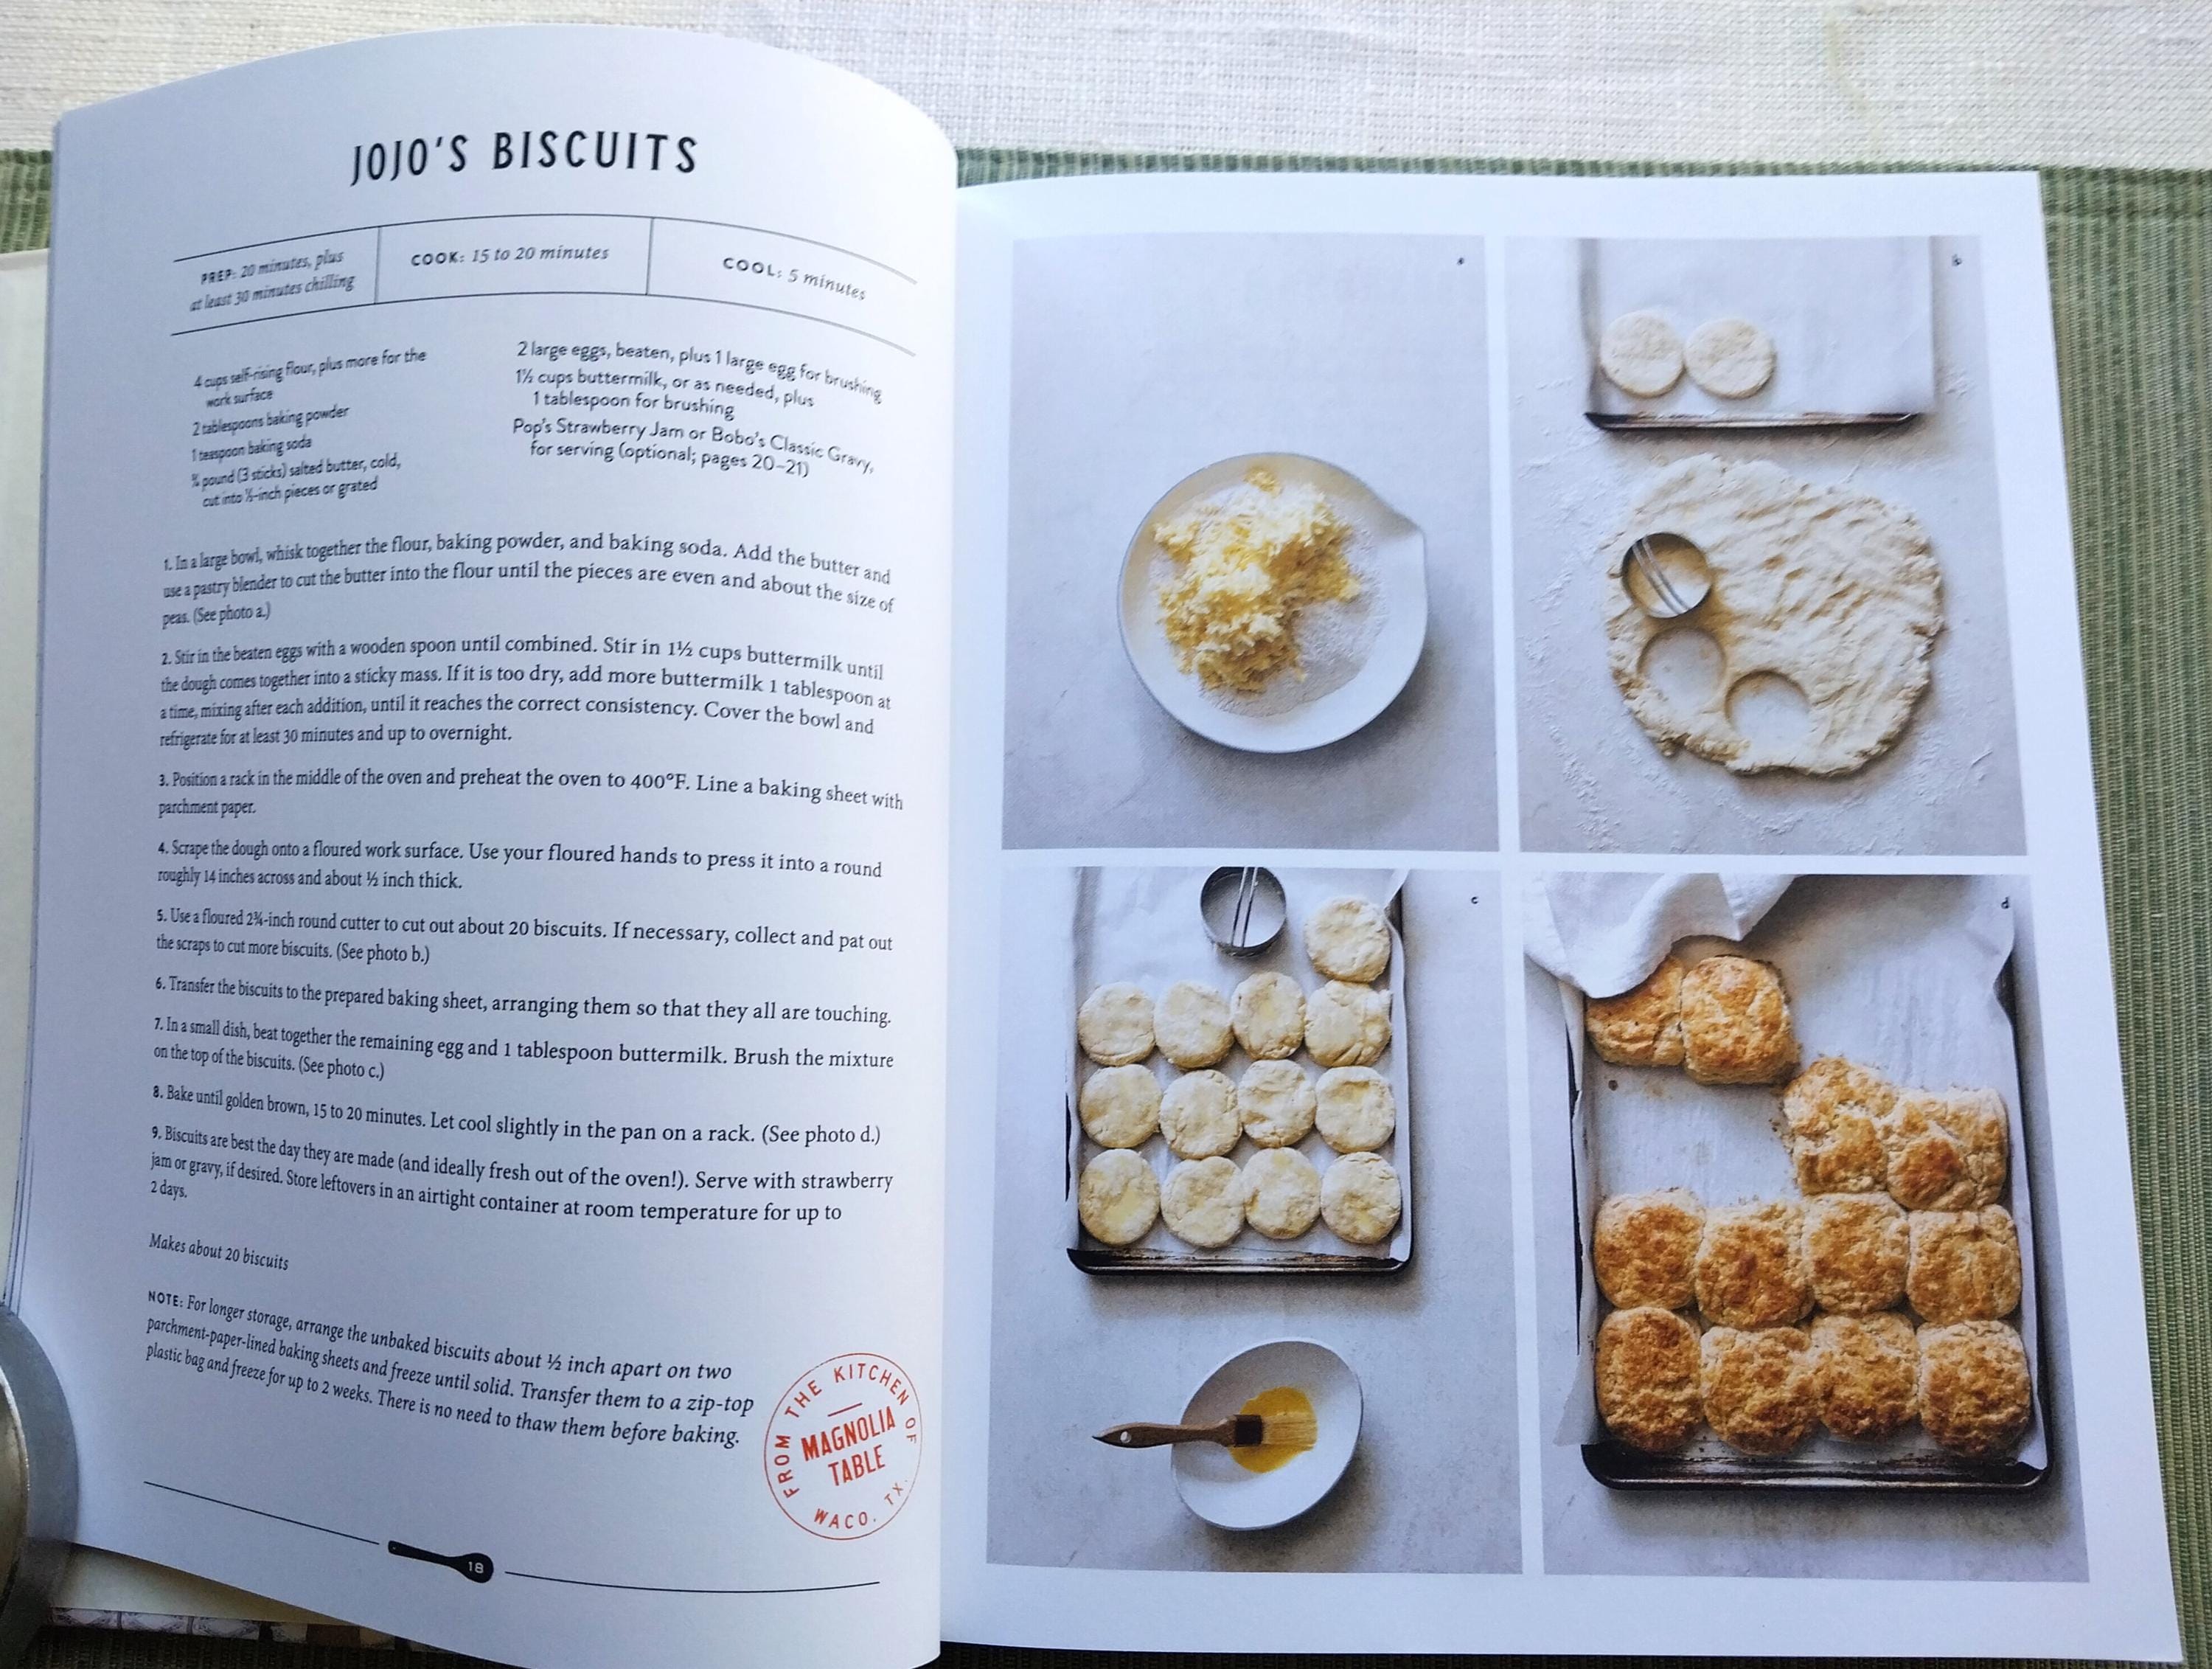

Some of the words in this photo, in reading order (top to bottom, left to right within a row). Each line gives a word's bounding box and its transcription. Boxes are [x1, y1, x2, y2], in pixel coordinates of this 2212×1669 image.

[349, 134, 469, 187] JOJO'S
[492, 130, 698, 174] BISCUITS
[201, 268, 237, 285] PREP:
[240, 264, 256, 278] 20
[257, 258, 313, 275] minutes,
[314, 249, 344, 271] plus
[411, 251, 465, 267] COOK:
[472, 249, 490, 264] 15
[494, 249, 510, 261] to
[514, 246, 536, 260] 20
[539, 245, 610, 260] minutes
[189, 299, 203, 312] at
[204, 294, 232, 309] least
[234, 289, 250, 306] 30
[252, 283, 303, 301] minutes
[304, 274, 356, 293] chilling
[723, 257, 782, 278] COOL:
[787, 268, 799, 283] 5
[803, 274, 865, 301] minutes
[193, 375, 203, 387] 4
[204, 375, 229, 390] cups
[230, 364, 284, 384] self-rising
[285, 361, 316, 375] flour,
[319, 356, 343, 377] plus
[346, 355, 379, 369] more
[381, 349, 402, 364] for
[404, 347, 427, 363] the
[517, 341, 528, 357] 2
[531, 341, 568, 362] large
[571, 345, 611, 362] eggs,
[616, 341, 675, 363] beaten,
[679, 347, 711, 367] plus
[716, 350, 721, 364] 1
[726, 350, 764, 375] large
[768, 362, 796, 382] egg
[800, 363, 821, 381] for
[825, 369, 882, 405] brushing
[538, 373, 573, 389] cups
[577, 368, 667, 390] buttermilk,
[672, 378, 690, 389] or
[694, 380, 711, 391] as
[715, 382, 779, 403] needed,
[783, 389, 814, 408] plus
[192, 421, 200, 437] 2
[201, 417, 264, 436] tablespoons
[266, 411, 304, 428] baking
[305, 404, 350, 427] powder
[534, 391, 539, 406] 1
[543, 390, 630, 412] tablespoon
[635, 392, 660, 409] for
[664, 394, 734, 422] brushing
[512, 417, 552, 439] Pop's
[556, 417, 647, 442] Strawberry
[649, 421, 684, 438] Jam
[689, 429, 706, 440] or
[712, 426, 765, 448] Bobo's
[770, 434, 824, 459] Classic
[827, 445, 874, 475] Gravy,
[161, 652, 172, 666] 2.
[175, 649, 195, 665] Stir
[197, 648, 209, 664] in
[212, 646, 232, 662] the
[233, 645, 273, 662] beaten
[275, 646, 303, 664] eggs
[305, 639, 335, 657] with
[338, 644, 347, 656] a
[349, 636, 406, 655] wooden
[409, 639, 456, 658] spoon
[462, 634, 501, 652] until
[504, 634, 598, 653] combined.
[603, 636, 638, 654] Stir
[641, 639, 660, 655] in
[698, 646, 742, 665] cups
[747, 645, 842, 673] buttermilk
[847, 663, 883, 681] until
[159, 730, 218, 751] refrigerate
[219, 728, 237, 745] for
[239, 731, 251, 744] at
[252, 727, 281, 744] least
[282, 729, 299, 745] 30
[300, 726, 355, 743] minutes
[357, 724, 383, 741] and
[387, 729, 406, 746] up
[410, 726, 425, 740] to
[429, 723, 512, 746] overnight.
[1470, 895, 1480, 905] c
[2000, 895, 2011, 910] d
[155, 976, 166, 990] 6.
[168, 975, 215, 994] Transfer
[218, 978, 236, 996] the
[238, 979, 283, 999] biscuits
[286, 985, 299, 999] to
[301, 983, 322, 1001] the
[324, 987, 384, 1008] prepared
[387, 988, 439, 1013] baking
[442, 990, 487, 1013] sheet,
[492, 996, 579, 1019] arranging
[583, 996, 630, 1016] them
[636, 1003, 658, 1016] so
[663, 998, 700, 1017] that
[706, 999, 749, 1024] they
[753, 1001, 776, 1019] all
[782, 1007, 810, 1021] are
[815, 1004, 891, 1029] touching.
[150, 1151, 173, 1170] jam
[174, 1158, 187, 1170] or
[189, 1160, 223, 1180] gravy,
[226, 1161, 237, 1178] if
[237, 1162, 283, 1184] desired.
[286, 1169, 318, 1189] Store
[320, 1173, 376, 1197] leftovers
[379, 1182, 394, 1199] in
[397, 1187, 414, 1201] an
[418, 1187, 476, 1212] airtight
[479, 1196, 560, 1215] container
[563, 1201, 580, 1215] at
[584, 1204, 634, 1218] room
[640, 1203, 759, 1225] temperature
[763, 1201, 791, 1221] for
[796, 1208, 819, 1226] up
[825, 1205, 842, 1220] to
[148, 1232, 186, 1253] Makes
[188, 1239, 223, 1260] about
[224, 1247, 240, 1263] 20
[243, 1247, 289, 1271] biscuits
[148, 1290, 184, 1308] NOTE:
[187, 1294, 207, 1312] For
[208, 1297, 245, 1322] longer
[247, 1308, 293, 1332] storage,
[295, 1317, 344, 1342] arrange
[347, 1324, 367, 1343] the
[371, 1330, 431, 1354] unbaked
[434, 1338, 490, 1363] biscuits
[494, 1347, 542, 1369] about
[567, 1355, 605, 1375] inch
[611, 1362, 663, 1381] apart
[667, 1365, 691, 1379] on
[697, 1364, 732, 1380] two
[784, 1379, 823, 1418] THE
[833, 1363, 909, 1406] KITCHEN
[801, 1405, 896, 1462] MAGNOLIA
[905, 1417, 917, 1444] OF
[774, 1434, 800, 1499] FROM
[827, 1444, 886, 1486] TABLE
[468, 1561, 484, 1574] 18
